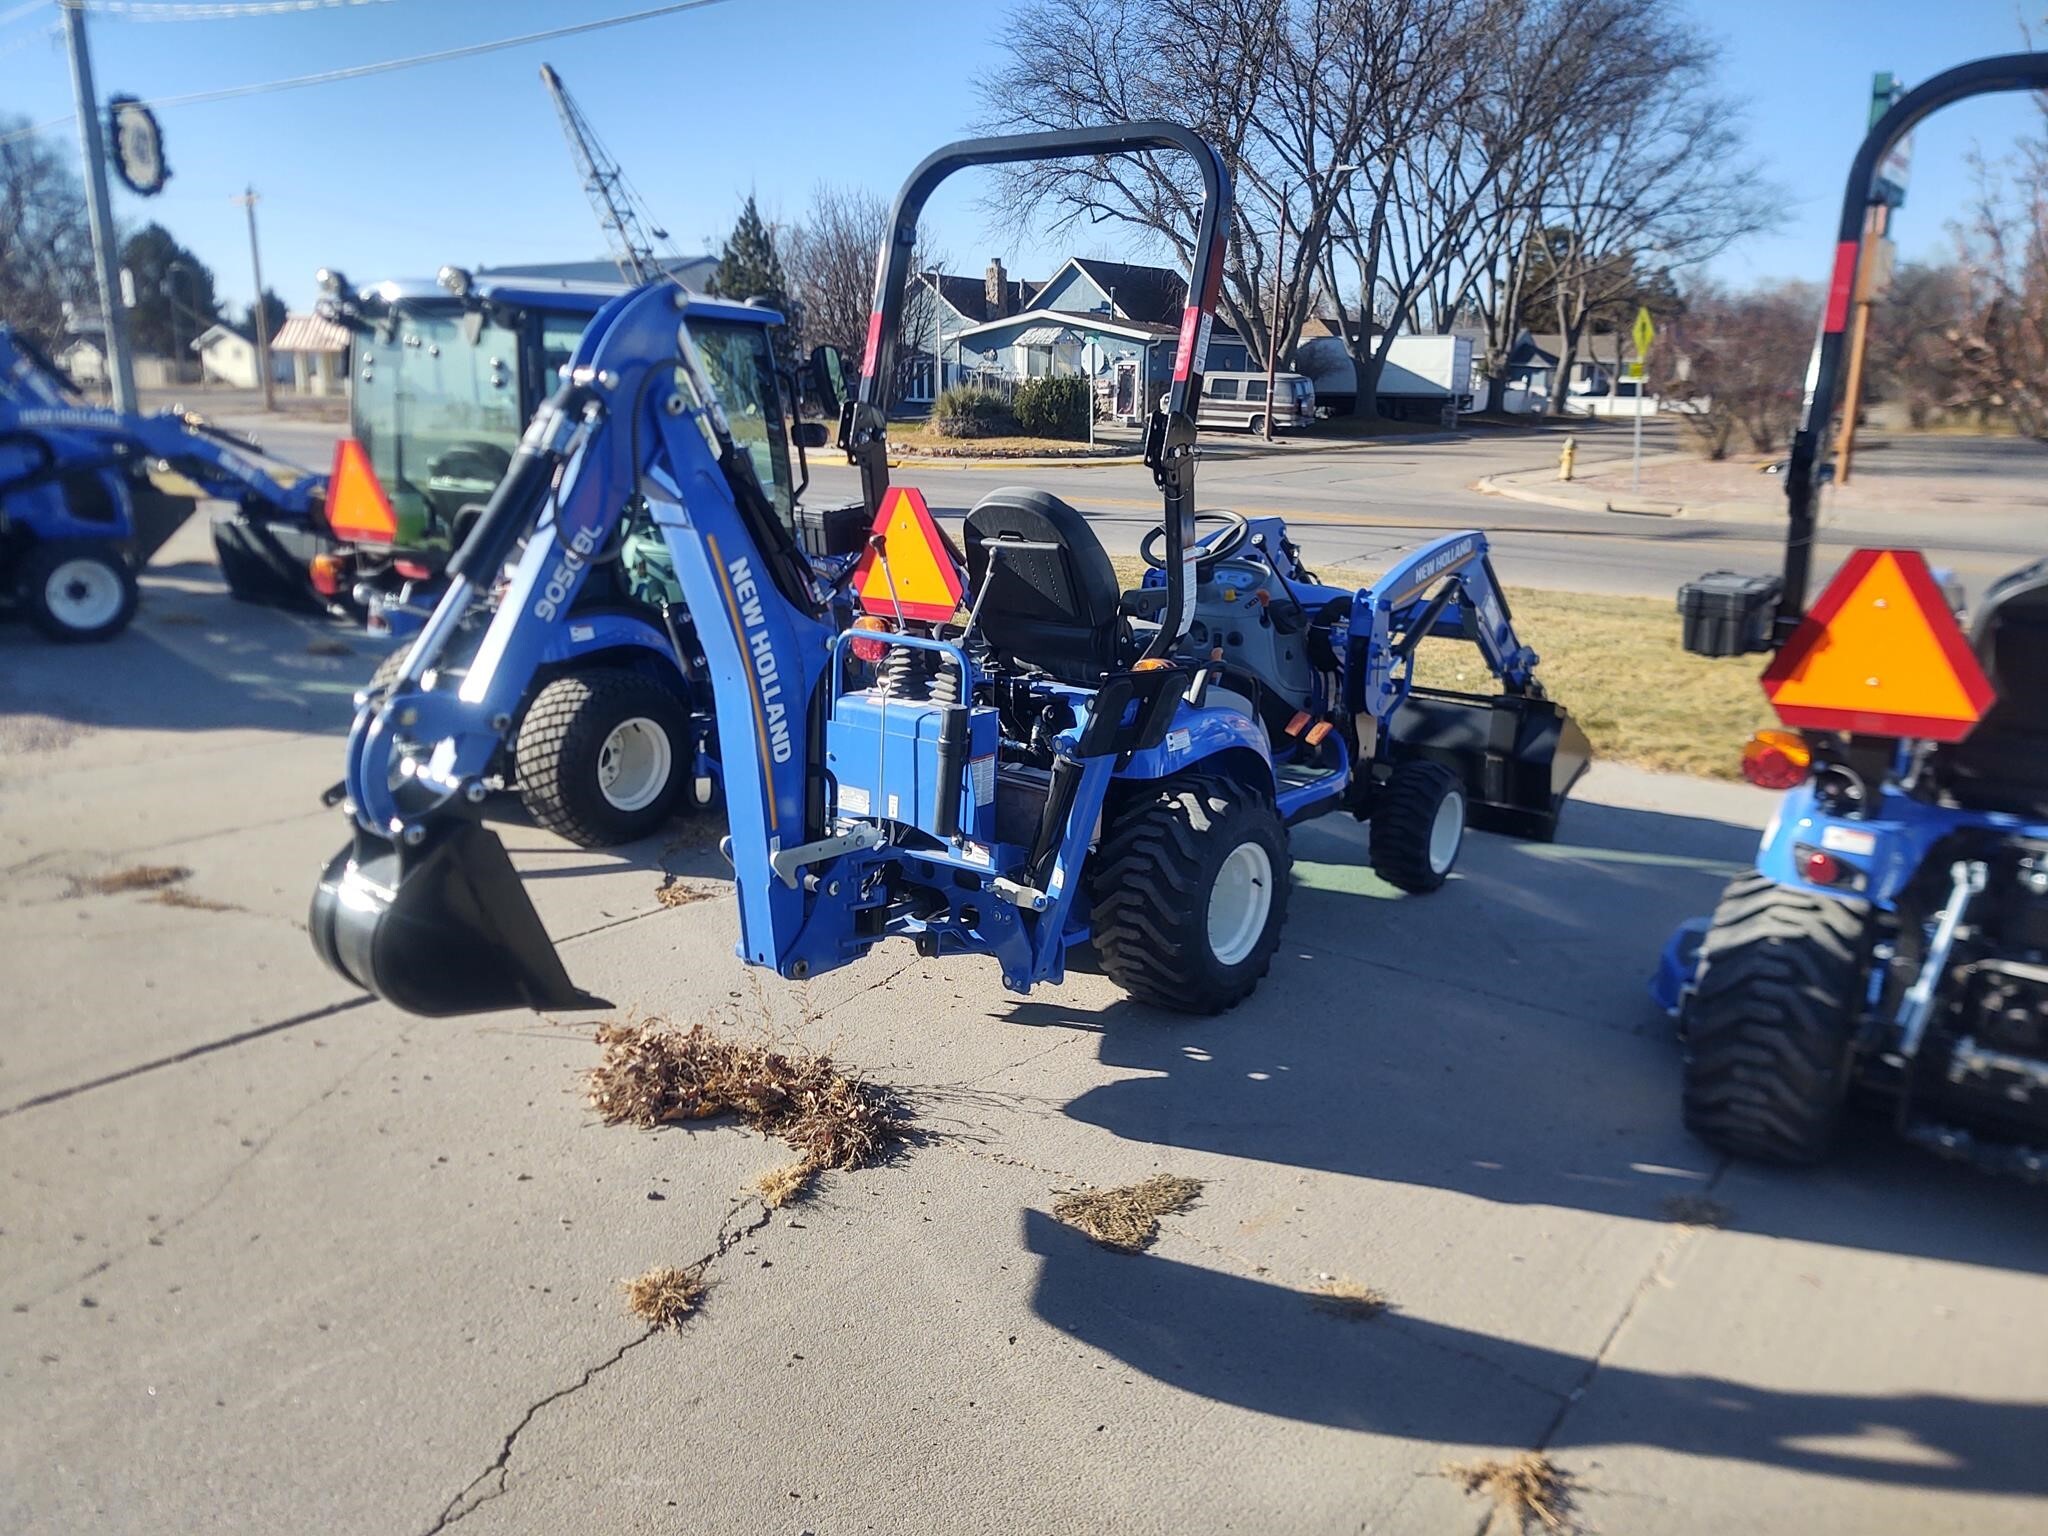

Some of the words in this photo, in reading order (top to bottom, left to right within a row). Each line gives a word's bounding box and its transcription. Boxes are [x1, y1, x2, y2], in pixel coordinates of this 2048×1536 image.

[1415, 559, 1435, 584] NEW
[1436, 538, 1472, 571] HOLLAND
[729, 556, 765, 627] NEW
[750, 630, 792, 764] HOLLAND
